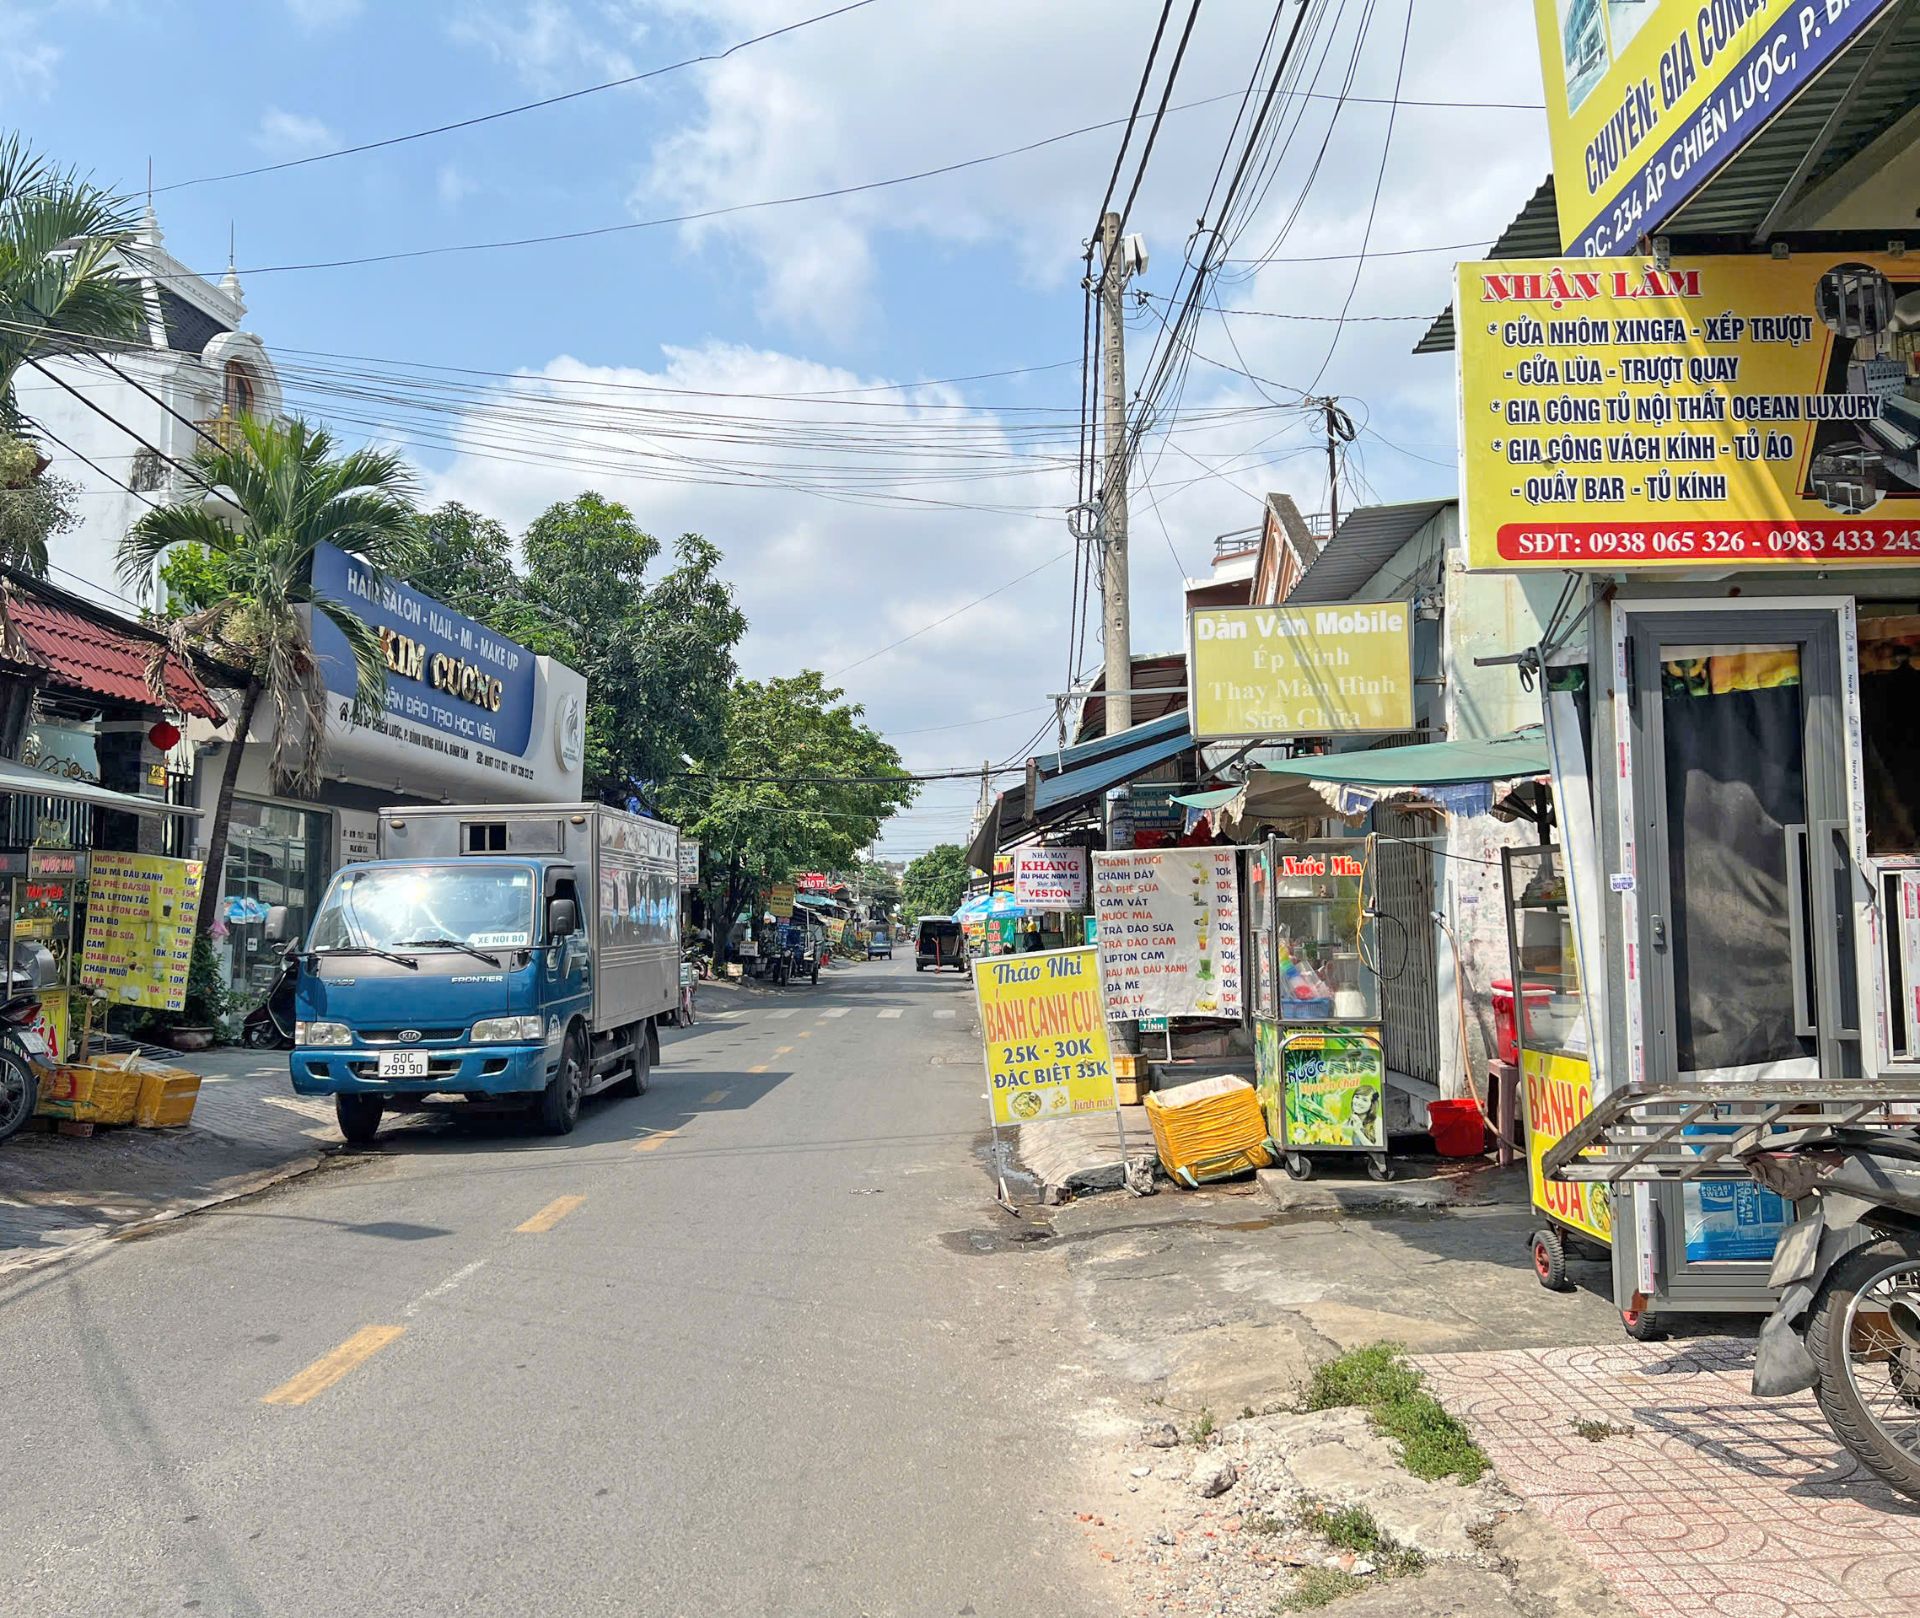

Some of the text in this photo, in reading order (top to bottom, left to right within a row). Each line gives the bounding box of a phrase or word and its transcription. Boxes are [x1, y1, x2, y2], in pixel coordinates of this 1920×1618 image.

[1585, 31, 1696, 195] CHUYÊN: GIA
[1613, 190, 1643, 242] 234
[1645, 158, 1667, 212] ẤP
[1670, 97, 1728, 180] CHIẾN
[1729, 33, 1797, 122] LƯỢC,
[1799, 6, 1822, 50] P.
[1482, 264, 1703, 310] NHẬN LÀM
[1503, 311, 1813, 348] CỬA NHÔM XINGFA XẾP TRƯỢT
[1518, 353, 1739, 388] CỬA LÙA TRƯỢT QUAY
[1506, 389, 1884, 428] GIA CÔNG TỦ NỘI THẤT OCEAN LUXURY
[1507, 428, 1794, 465] GIA CÔNG VÁCH KÍNH TỦ ÁO
[1525, 469, 1728, 506] QUẦY BAR TỦ KÍNH
[1518, 529, 1920, 554] SĐT: 0938 065 326 0983 433 243
[1315, 610, 1404, 635] Mobile
[429, 610, 453, 641] NAIL
[460, 627, 473, 651] MI
[480, 637, 506, 666] MAKE
[507, 650, 519, 672] UP
[430, 652, 503, 713] CƯƠNG
[1207, 675, 1396, 705] Thay Màn Hình
[1214, 853, 1231, 864] 10k
[1021, 861, 1080, 872] KHANG
[1282, 855, 1362, 877] Nước Mía
[1098, 870, 1131, 881] CHANH
[1216, 867, 1232, 876] 10k
[1216, 881, 1232, 890] 10k
[1028, 889, 1072, 898] VESTON
[1100, 899, 1124, 908] CAM
[1217, 895, 1233, 904] 10k
[1217, 908, 1233, 918] 10k
[1218, 922, 1234, 932] 10k
[86, 940, 105, 949] CAM
[478, 936, 490, 944] XE
[1152, 936, 1177, 946] CAM
[1220, 937, 1236, 946] 10k
[1104, 950, 1236, 964] LIPTON CAM 10k
[992, 955, 1082, 985] Thảo Nhi
[1164, 963, 1189, 973] XANH
[1221, 964, 1237, 974] 10k
[451, 975, 504, 985] FRONTIER
[1125, 981, 1140, 990] ME
[1222, 980, 1238, 989] 10k
[1133, 994, 1144, 1004] LY
[1222, 993, 1237, 1003] 15k
[984, 987, 1104, 1043] BÁNH CANH CUA
[1224, 1008, 1240, 1017] 10k
[402, 1032, 417, 1040] KIA
[1003, 1038, 1093, 1064] 25K 30K
[393, 1053, 414, 1064] 60C
[994, 1060, 1109, 1091] ĐẶC BIỆT 35K
[1527, 1058, 1576, 1138] BÁNH
[1701, 1185, 1731, 1193] POCARI
